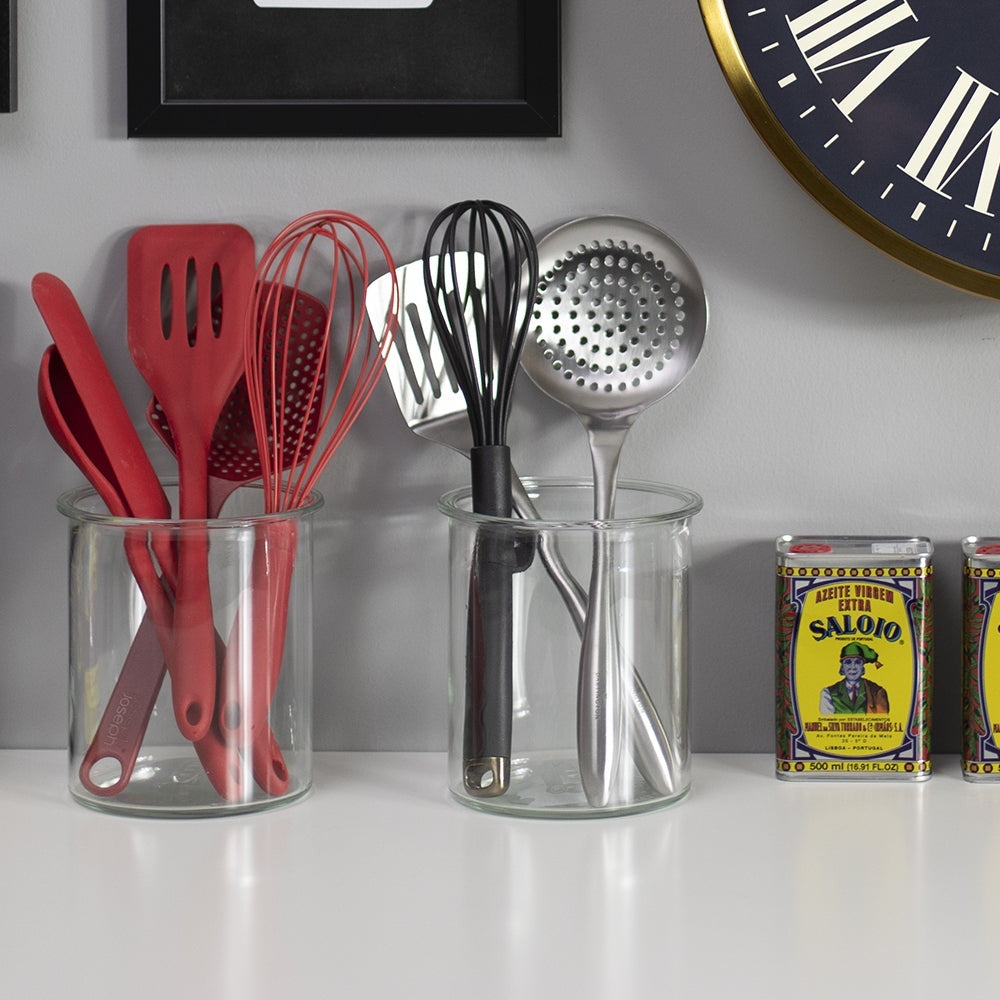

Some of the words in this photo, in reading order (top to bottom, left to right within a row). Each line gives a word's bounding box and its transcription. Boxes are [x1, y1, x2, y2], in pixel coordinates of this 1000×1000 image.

[815, 586, 851, 604] AZEITE
[855, 585, 894, 604] VIRGEM
[838, 599, 872, 612] EXTRA
[809, 615, 902, 642] SALOIO
[847, 763, 869, 772] (16.91
[872, 763, 899, 772] FL.OZ)
